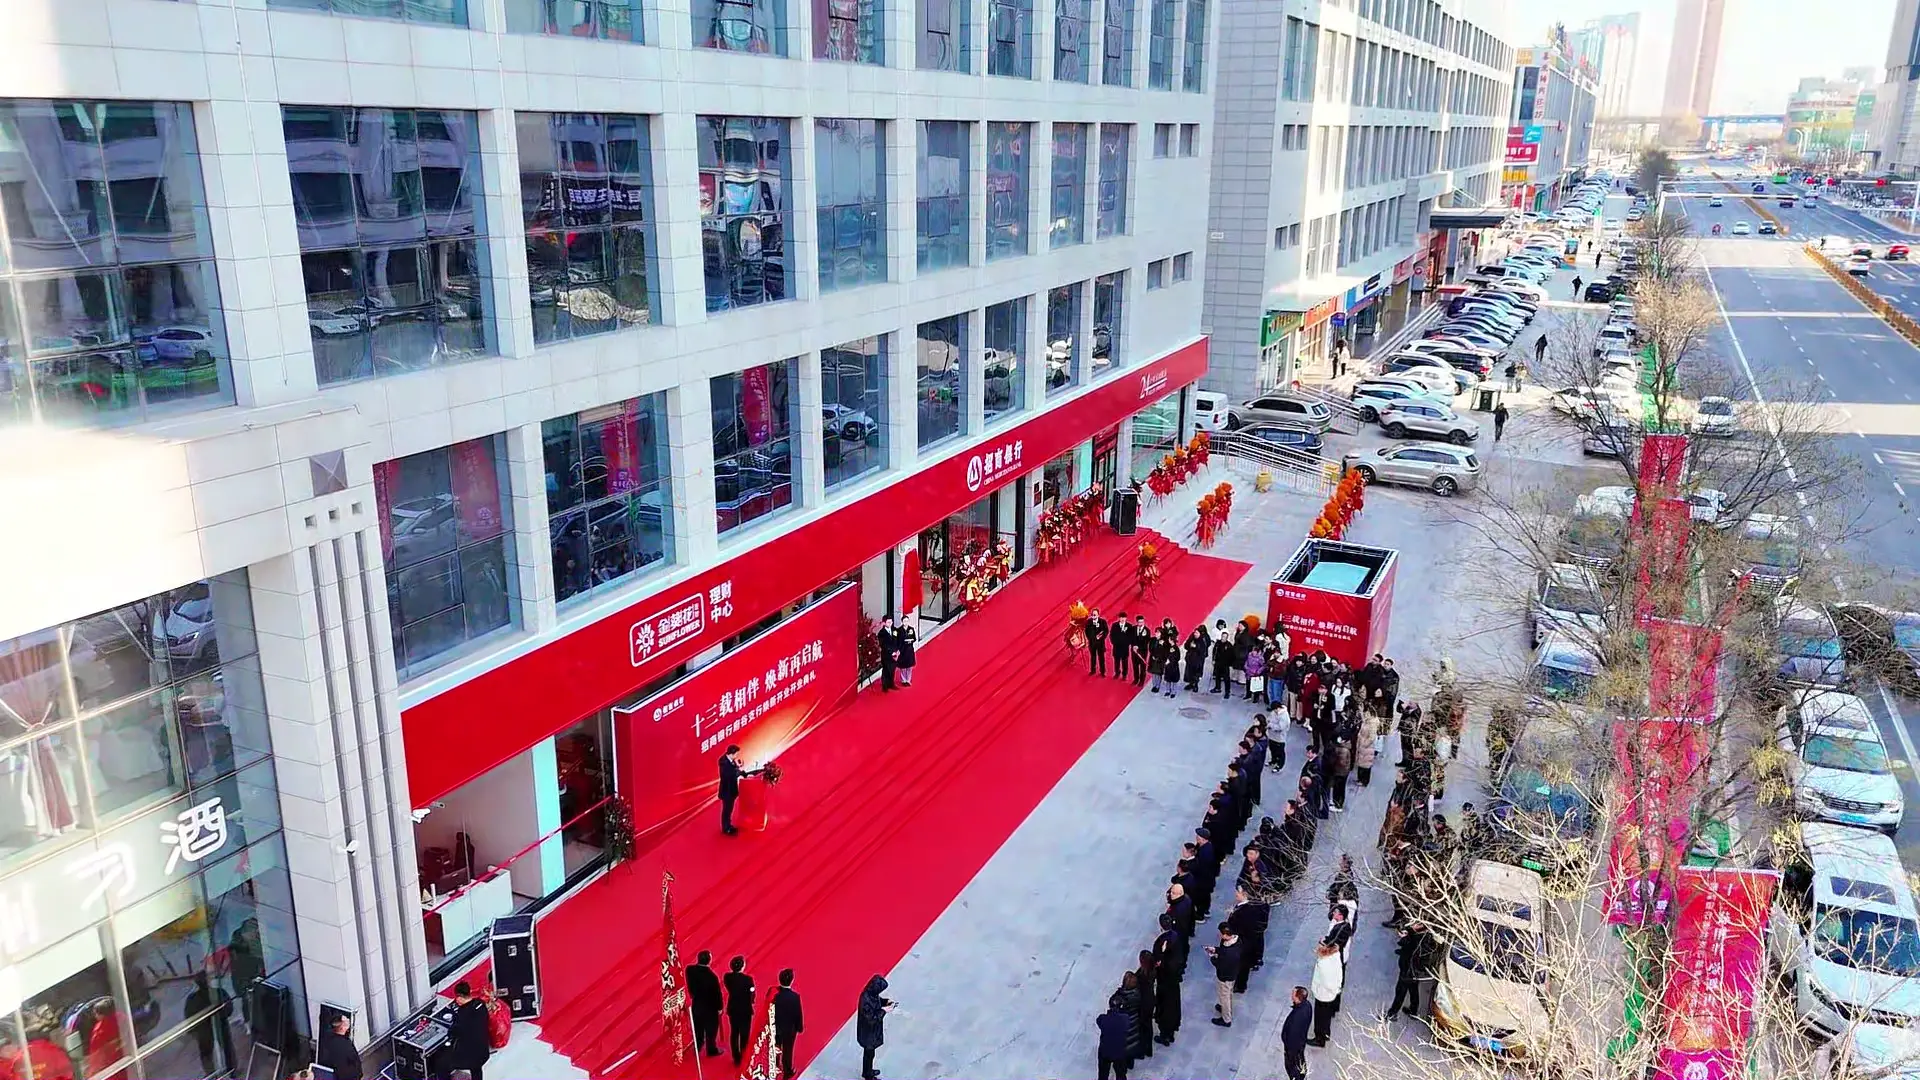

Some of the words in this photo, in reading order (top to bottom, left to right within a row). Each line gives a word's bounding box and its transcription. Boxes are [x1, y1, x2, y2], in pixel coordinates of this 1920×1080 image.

[984, 440, 1023, 476] 招商银行
[709, 580, 732, 605] 理财
[658, 605, 695, 637] 金葵花
[711, 601, 733, 624] 中心
[658, 620, 700, 648] SUNFLOWER
[691, 677, 760, 738] 十三载相伴
[765, 640, 824, 693] 焕新再启航
